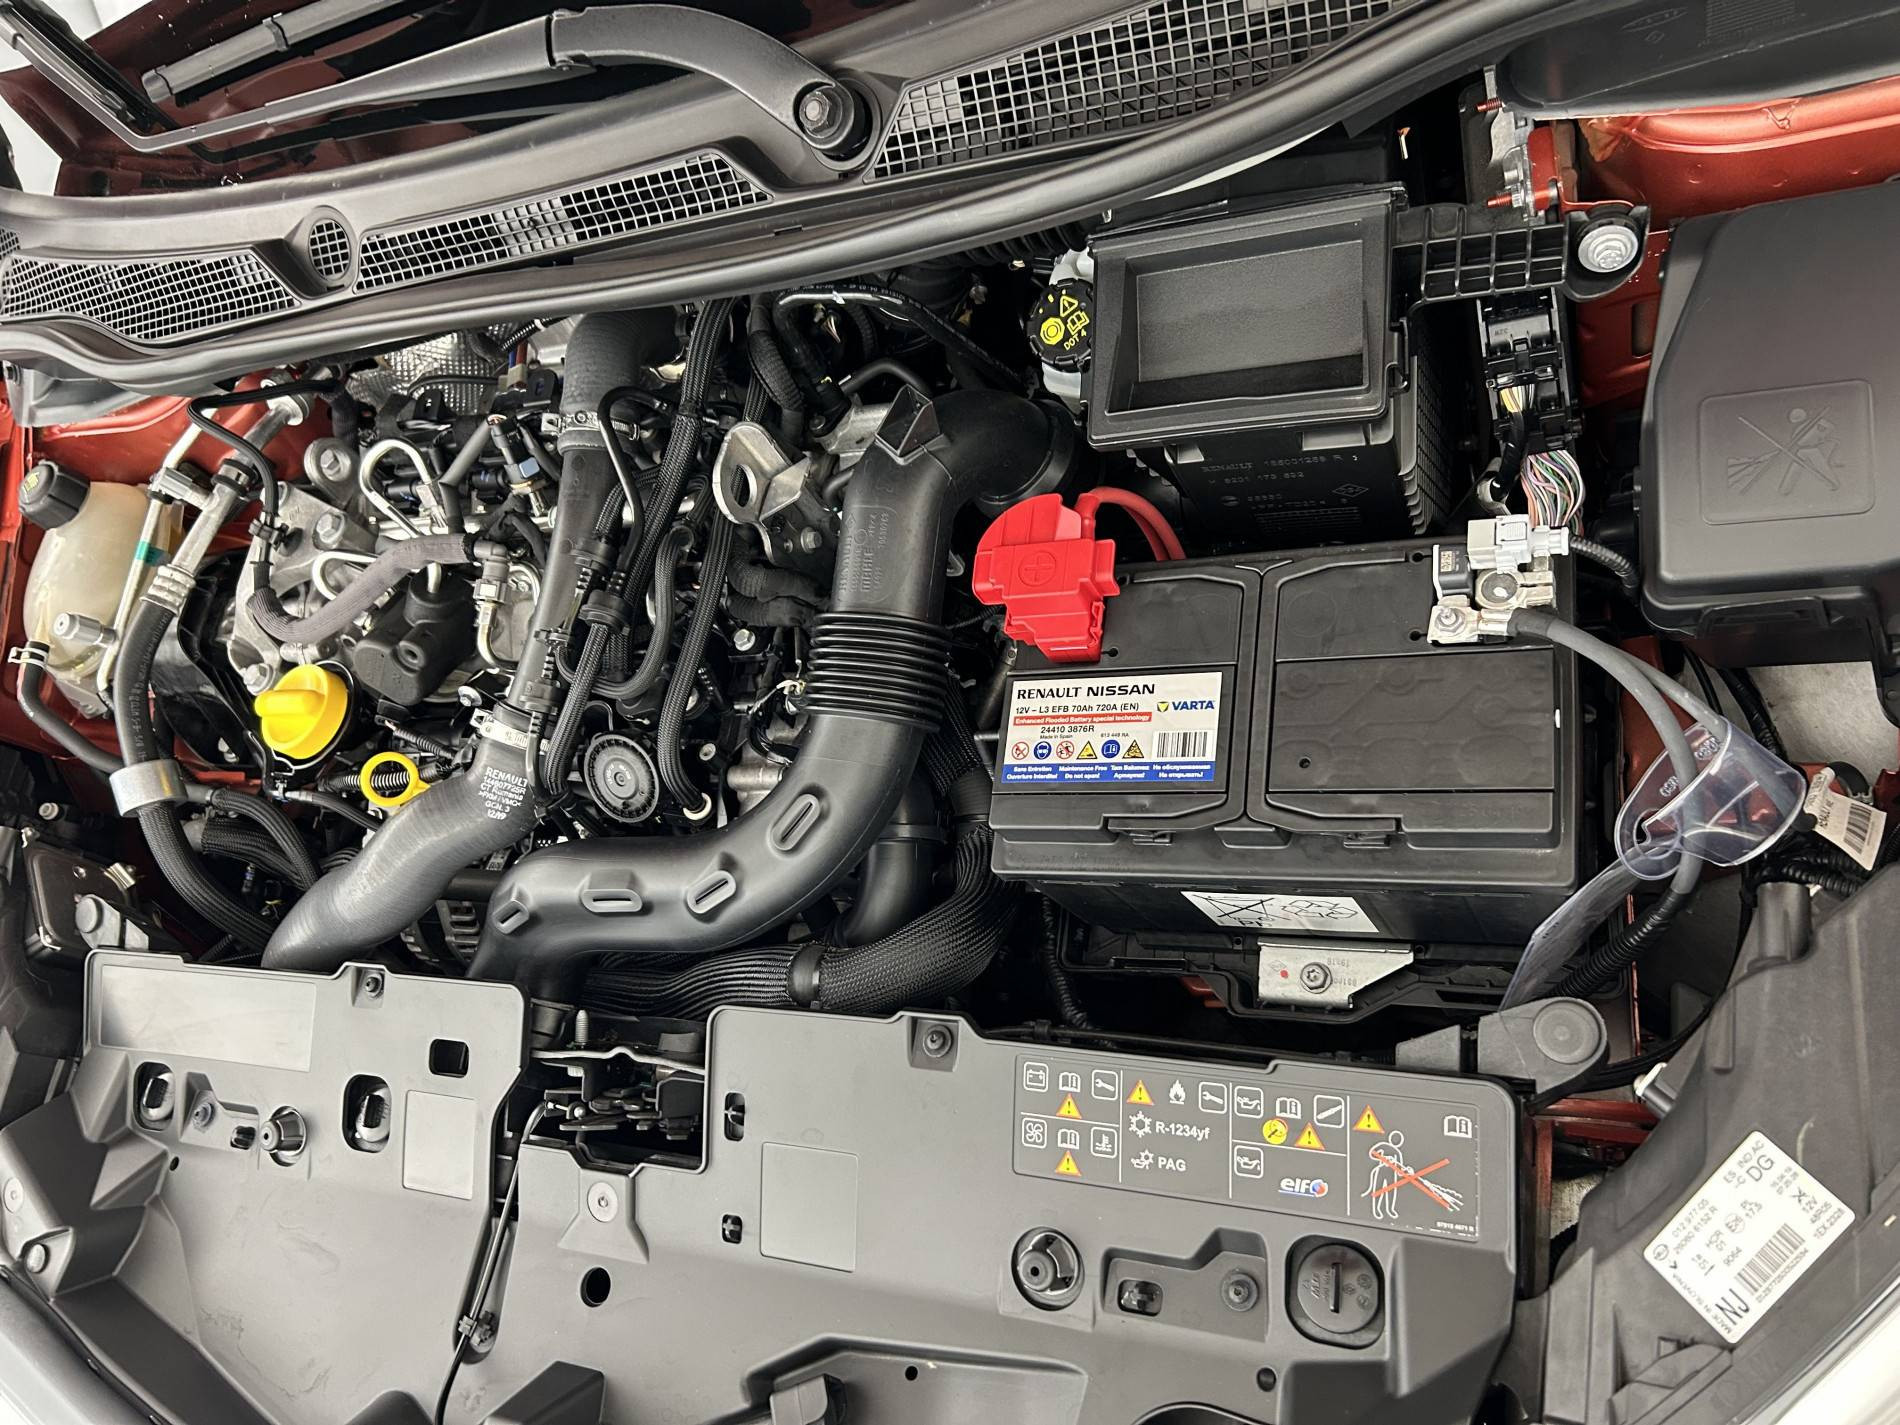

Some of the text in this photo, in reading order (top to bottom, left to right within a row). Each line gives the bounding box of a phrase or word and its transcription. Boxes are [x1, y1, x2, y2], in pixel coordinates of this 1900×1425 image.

[1064, 334, 1079, 350] DOT
[1017, 684, 1155, 699] RENAULT NISSAN
[1039, 705, 1049, 713] L3
[1052, 705, 1069, 713] EFB
[1072, 704, 1093, 712] 70Ah
[1096, 704, 1118, 712] 720A
[1120, 703, 1139, 712] (EN)
[1172, 700, 1214, 710] VARTA
[1070, 716, 1091, 724] Battery
[1093, 715, 1114, 723] special
[1115, 714, 1149, 722] technology
[485, 767, 528, 787] RENAULT
[492, 787, 523, 800] Romania
[1155, 1120, 1210, 1141] R-1234yf
[1157, 1157, 1186, 1172] PAG
[1746, 1153, 1774, 1182] DG
[1280, 1178, 1311, 1194] elf
[1714, 1288, 1751, 1324] NJ
